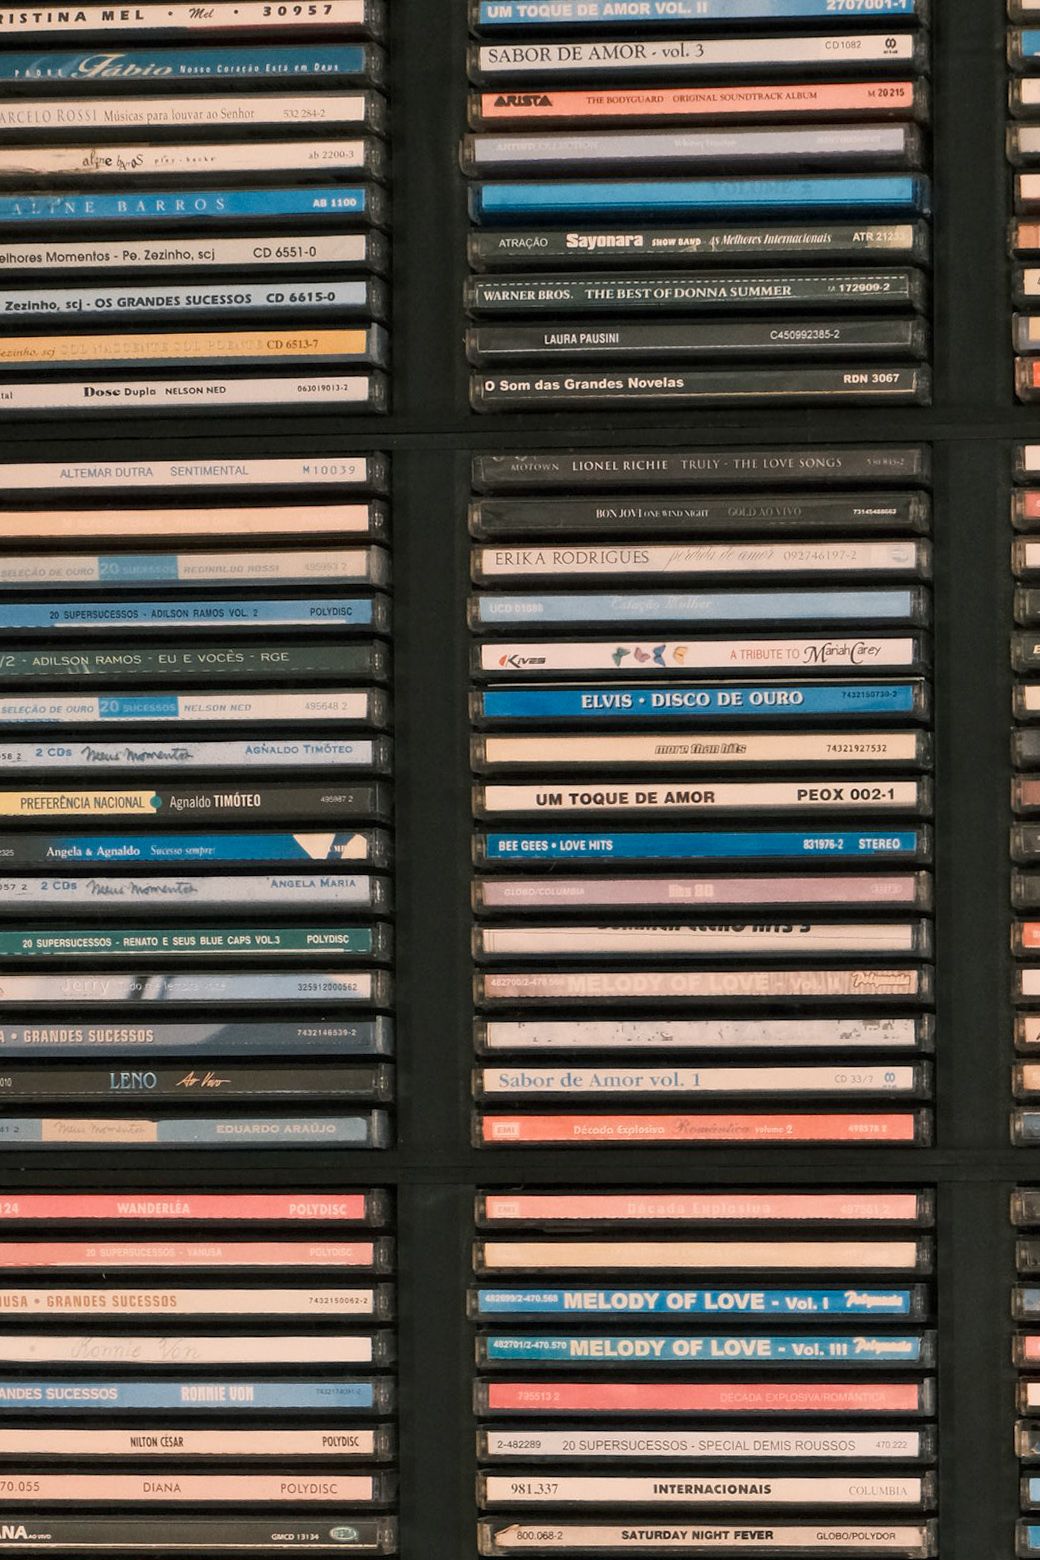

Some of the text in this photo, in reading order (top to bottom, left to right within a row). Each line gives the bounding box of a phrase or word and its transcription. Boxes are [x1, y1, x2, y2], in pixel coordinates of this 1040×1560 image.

[102, 4, 334, 21] MEL 30957
[488, 44, 704, 63] SABOR DE AMOR vol. 3
[494, 95, 553, 107] ARISTA
[5, 292, 336, 311] Zezinho, scj OS GRANDES SUCESSOS CD 6615-0
[485, 373, 899, 391] O Som das Grandes Novelas RDN 3067
[60, 465, 248, 478] ALTEMAR DUTRA SENTIMENTAL
[572, 457, 842, 470] LIONEL RICHIE TRULY THE LOVE SONGS
[32, 650, 289, 667] ADILSON RAMOS EU E VOCÊS RGE
[581, 691, 803, 708] ELVIS DISCO DE OURO
[110, 1072, 156, 1089] LENO
[563, 1294, 828, 1309] MELODY OF LOVE Vol. I
[143, 1482, 337, 1494] DIANA POLYDISC
[653, 1484, 771, 1494] INTERNACIONAIS
[622, 1531, 773, 1541] SATURDAY NIGHT FEVER
